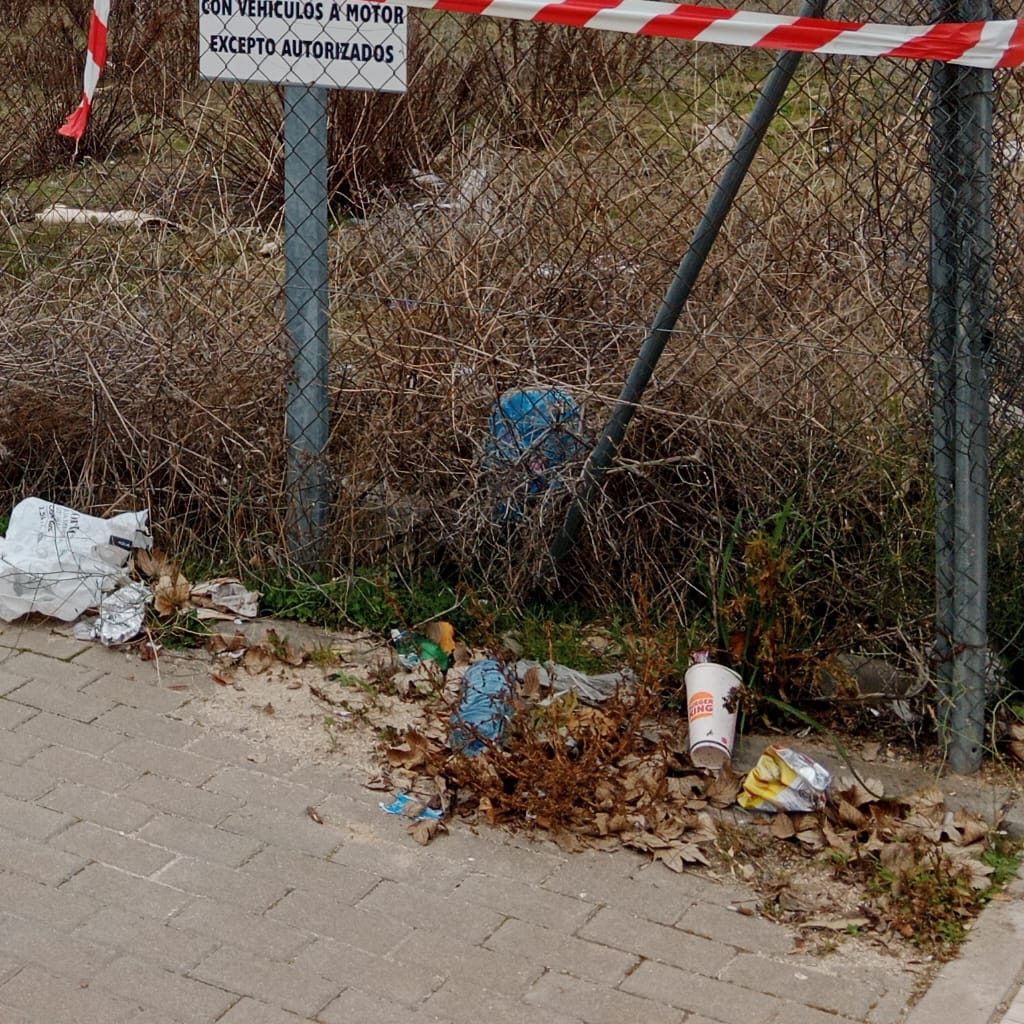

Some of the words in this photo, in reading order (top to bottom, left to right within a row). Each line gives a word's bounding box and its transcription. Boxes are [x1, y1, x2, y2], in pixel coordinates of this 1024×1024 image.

[329, 1, 340, 22] A
[346, 3, 404, 24] MOTOR
[210, 34, 275, 56] EXCEPTO
[281, 38, 394, 64] AUTORIZADOS
